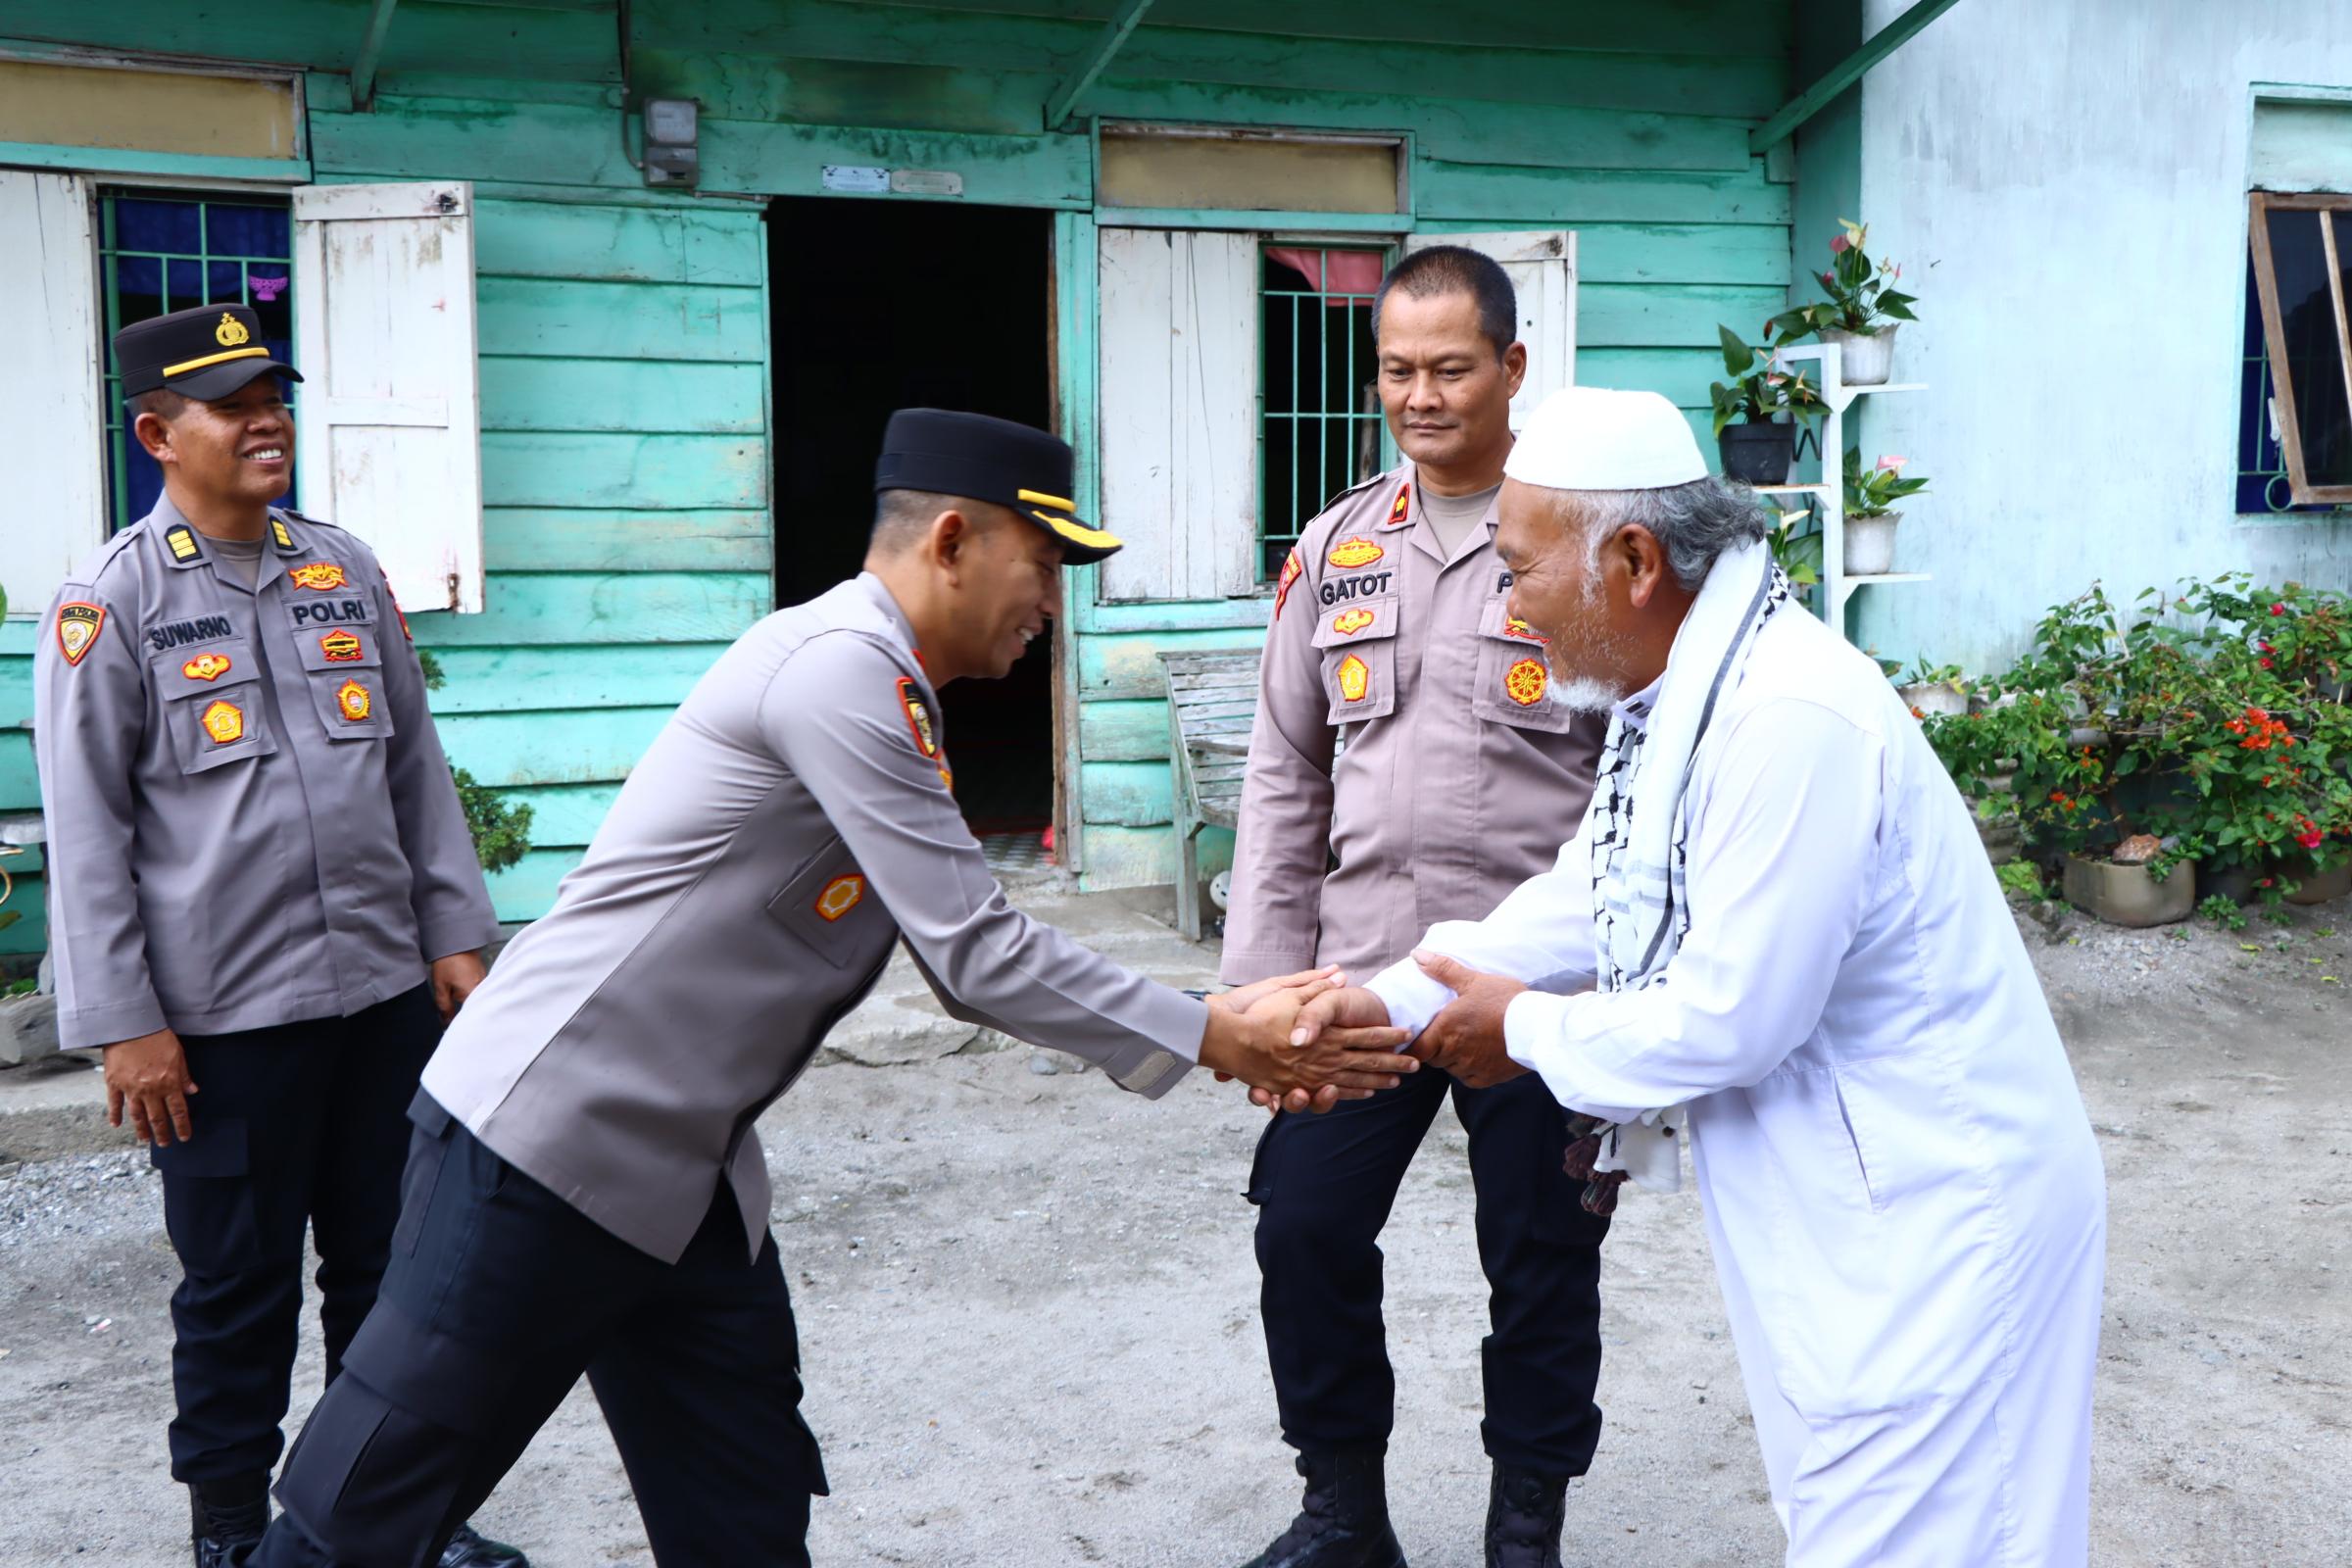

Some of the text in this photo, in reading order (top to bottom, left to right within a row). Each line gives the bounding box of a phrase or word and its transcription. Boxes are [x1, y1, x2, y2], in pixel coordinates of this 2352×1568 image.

[1319, 571, 1393, 606] GATOT
[292, 599, 367, 625] POLRI
[150, 615, 232, 651] SUWARNO
